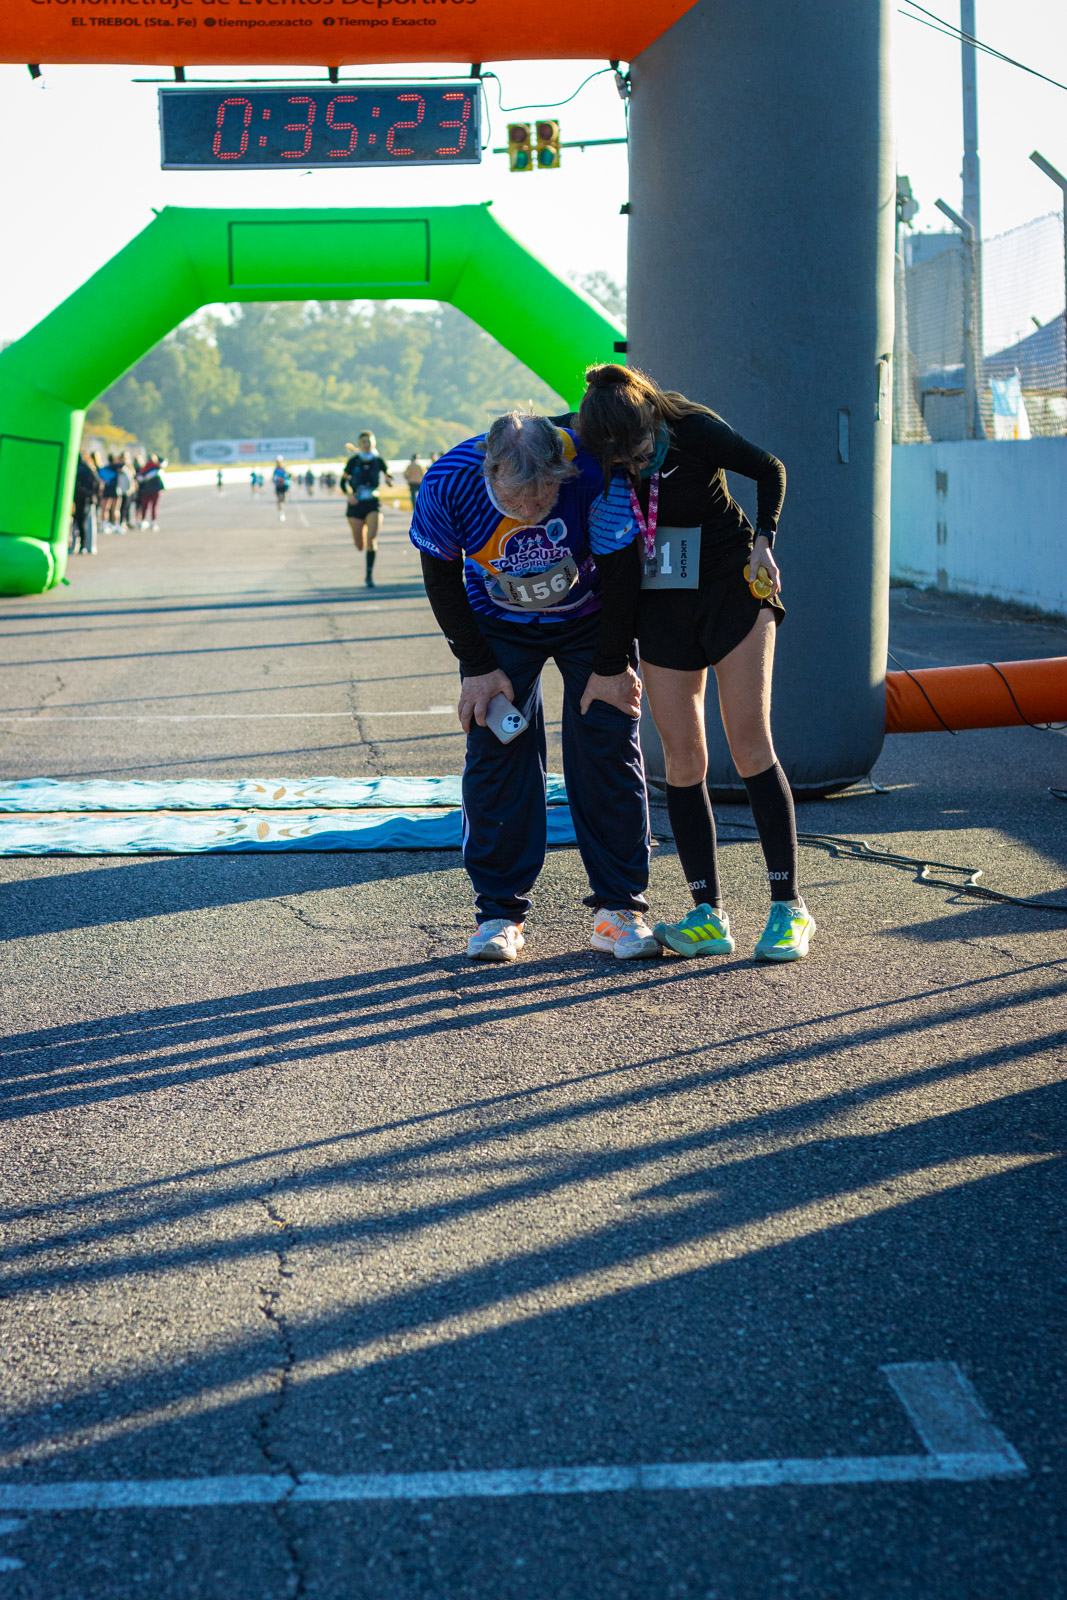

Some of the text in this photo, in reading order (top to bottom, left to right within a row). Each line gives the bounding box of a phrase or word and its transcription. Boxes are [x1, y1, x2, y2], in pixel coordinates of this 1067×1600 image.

[71, 17, 198, 28] EL TREBOL (Sta. Fe)
[337, 17, 437, 29] Tiempo Exacto
[212, 93, 472, 160] 0:35:23
[680, 539, 688, 579] EXACTO
[514, 560, 548, 572] CORRE
[516, 573, 567, 603] 156
[769, 871, 789, 881] SOX
[688, 879, 707, 891] SOX
